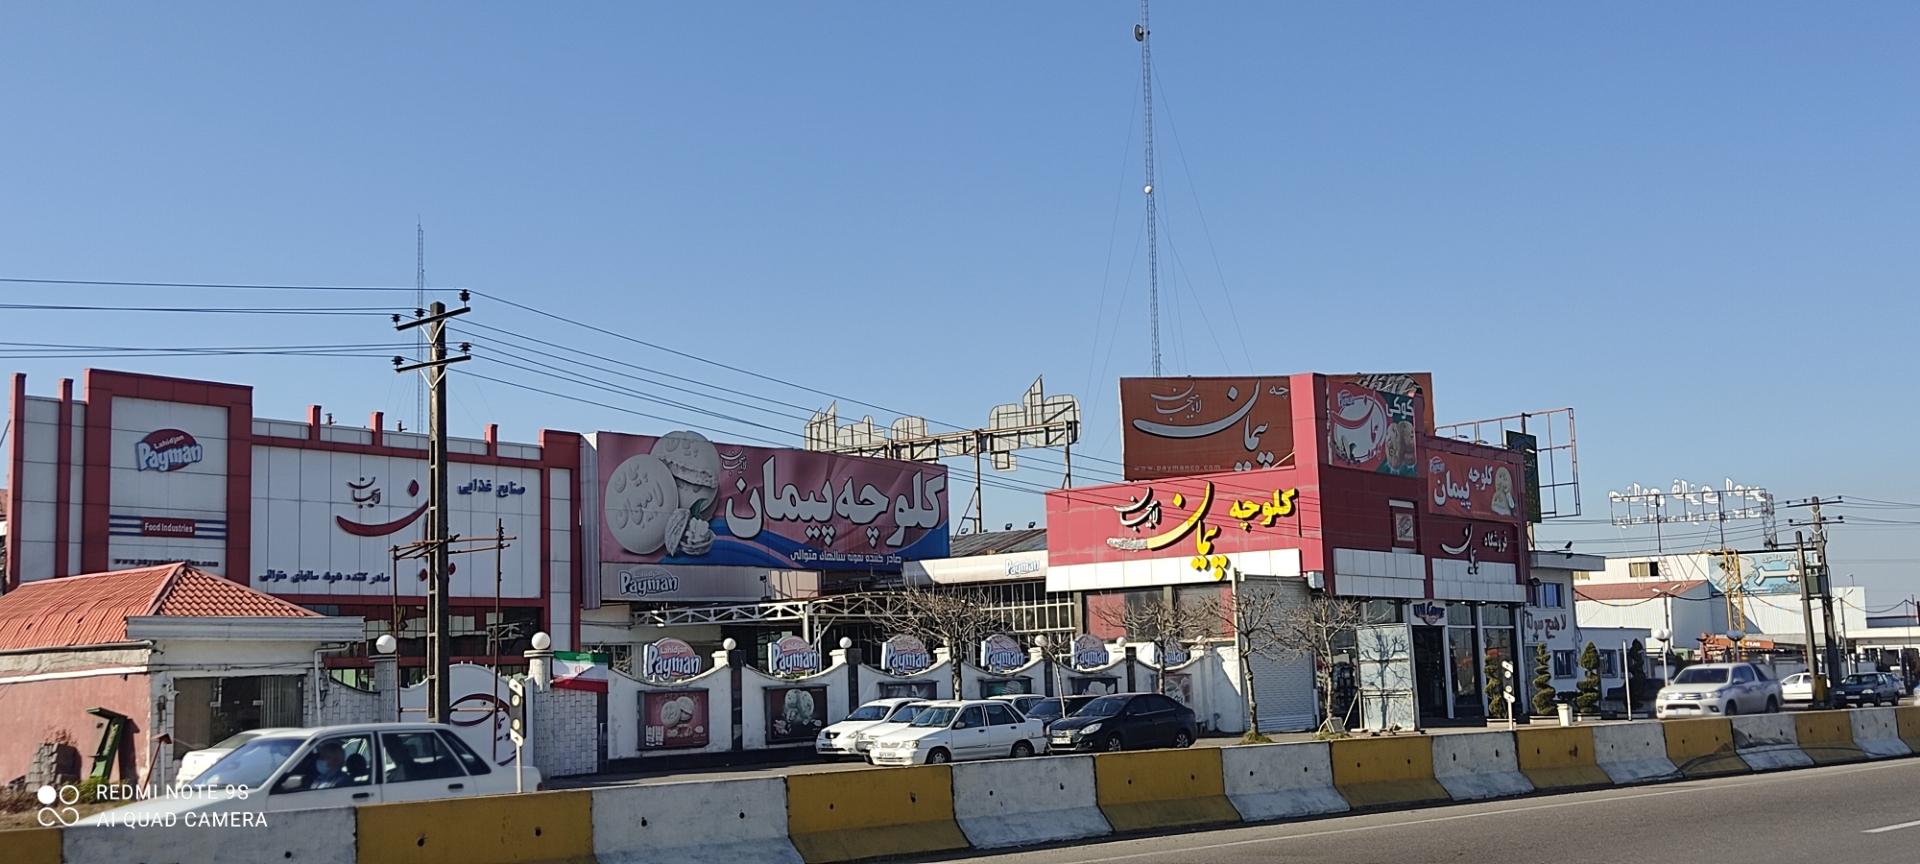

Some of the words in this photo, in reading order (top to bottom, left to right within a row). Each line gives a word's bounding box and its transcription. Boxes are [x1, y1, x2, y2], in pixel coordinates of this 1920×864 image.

[135, 440, 203, 472] Payman
[495, 480, 526, 498] صنایع
[1433, 470, 1471, 510] پیمان
[1468, 464, 1493, 490] کلوچه
[725, 455, 834, 547] پیمان
[834, 469, 945, 548] کلوچه
[1229, 487, 1297, 530] کلوچه
[144, 522, 160, 532] Food
[161, 523, 193, 533] Industries
[1004, 558, 1041, 578] Payman
[619, 570, 680, 598] Payman
[648, 644, 702, 680] Payman
[772, 643, 818, 675] Payman
[885, 641, 930, 672] Payman
[985, 643, 1024, 667] Payman
[1074, 643, 1110, 666] Payman
